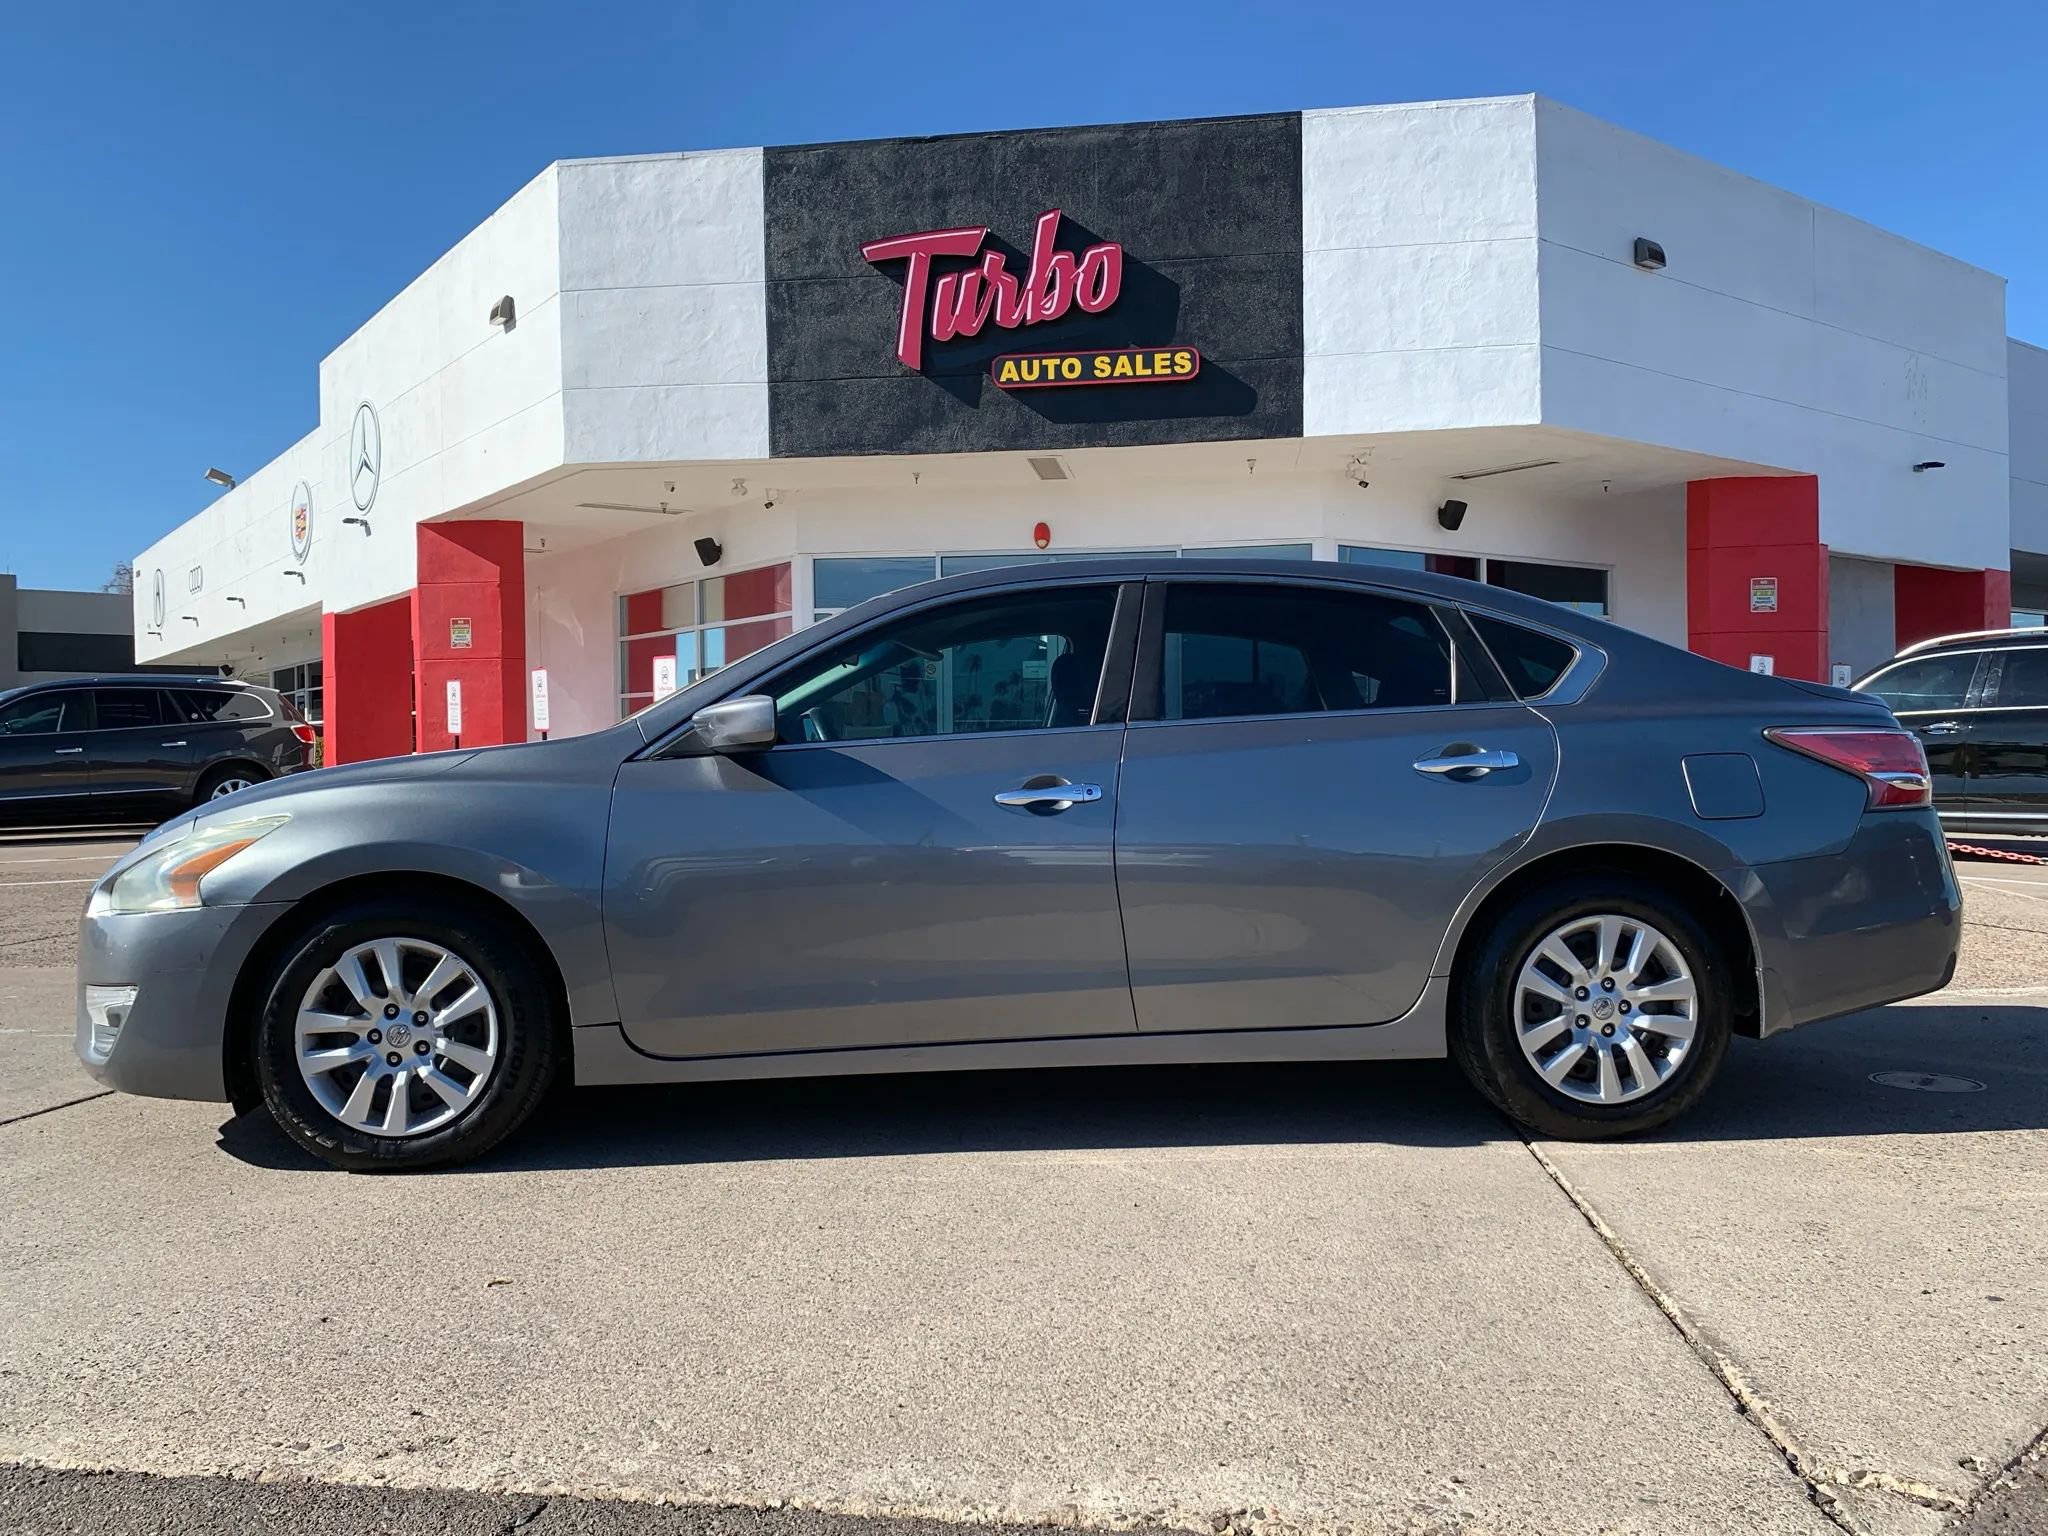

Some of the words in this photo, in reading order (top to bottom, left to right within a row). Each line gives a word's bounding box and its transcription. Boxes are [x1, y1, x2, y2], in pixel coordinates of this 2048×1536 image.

[860, 208, 1122, 370] Turbo
[1000, 357, 1082, 382] AUTO
[1093, 351, 1192, 377] SALES
